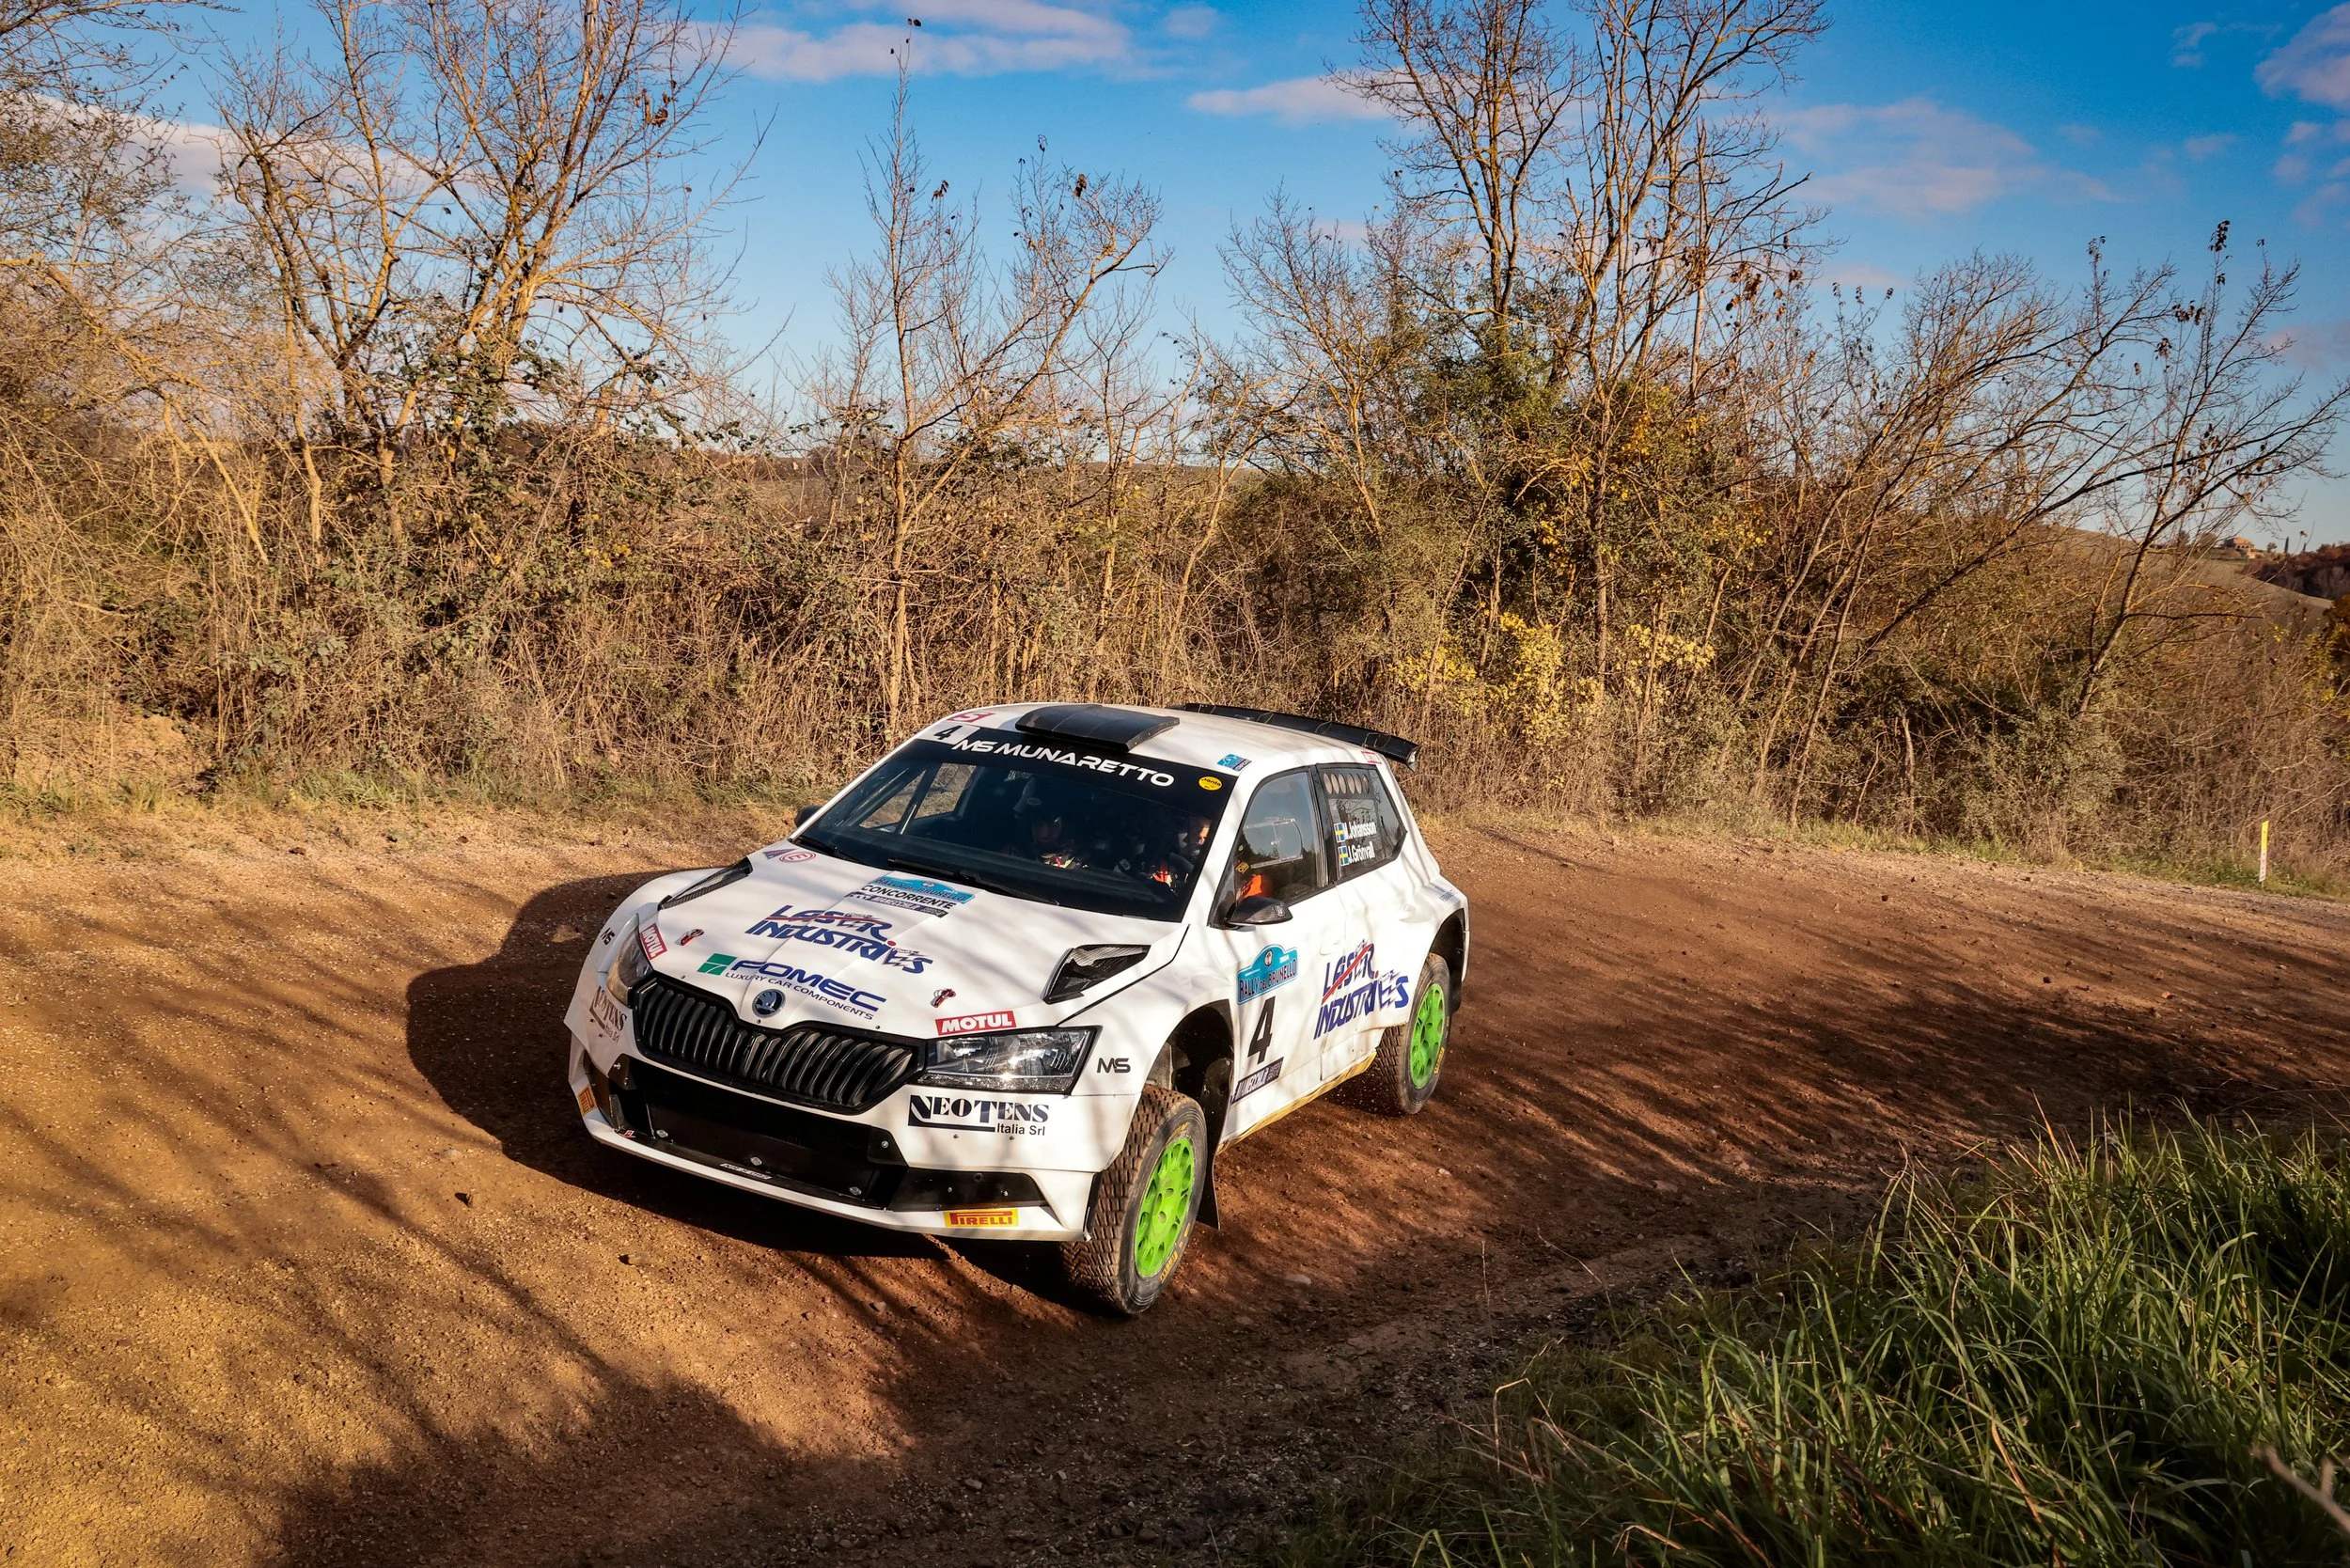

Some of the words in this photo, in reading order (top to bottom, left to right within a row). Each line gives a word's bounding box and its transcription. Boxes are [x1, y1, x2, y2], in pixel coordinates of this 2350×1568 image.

[933, 725, 955, 742] 4
[951, 739, 999, 753] MS
[994, 743, 1175, 787] MUNARETTO
[861, 885, 957, 910] CONCORRENTE
[640, 926, 664, 958] MOTUL
[730, 960, 887, 1012] FOMEC
[1239, 977, 1260, 999] RALLY
[1268, 958, 1297, 987] BRUNELLO
[725, 972, 768, 982] LUXURY
[767, 977, 792, 989] CAR
[792, 984, 875, 1021] COMPONENTS
[941, 1012, 1014, 1034] MOTUL
[1247, 996, 1276, 1065] 4
[1096, 1058, 1132, 1074] MS
[908, 1094, 1050, 1124] NEOTENS
[996, 1122, 1026, 1136] Italia
[1029, 1124, 1046, 1137] Srl
[949, 1211, 1013, 1225] PIRELLI
